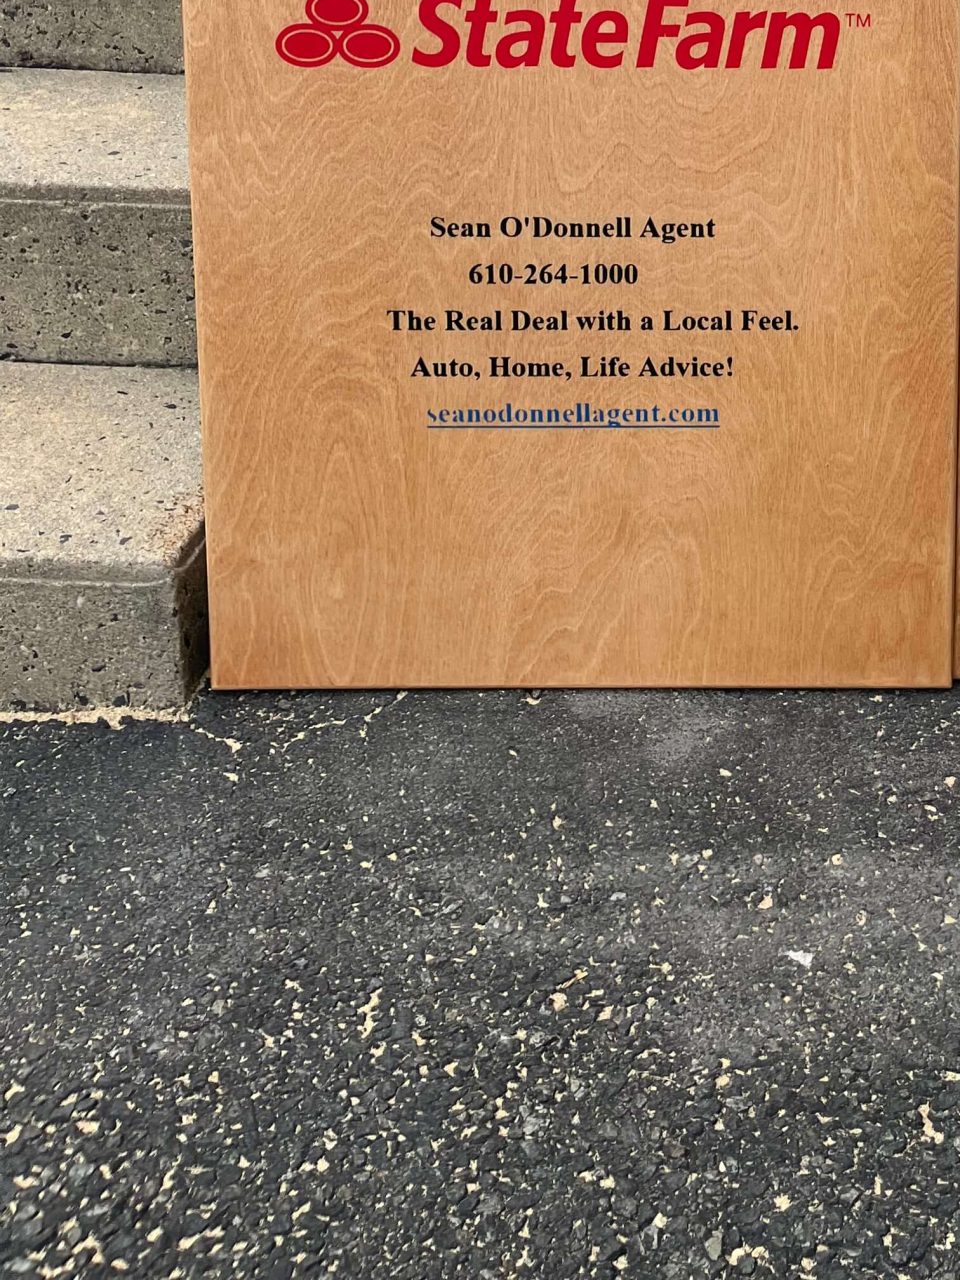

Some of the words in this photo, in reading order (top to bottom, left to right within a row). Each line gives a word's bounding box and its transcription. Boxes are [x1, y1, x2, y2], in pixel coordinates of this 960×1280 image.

[431, 217, 491, 237] Sean
[501, 217, 631, 237] O'Donnell
[640, 218, 715, 243] Agent
[469, 264, 637, 284] 610-264-1000
[387, 311, 435, 330] The
[445, 310, 502, 330] Real
[512, 311, 567, 330] Deal
[576, 311, 630, 330] with
[641, 317, 653, 330] a
[664, 311, 732, 330] Local
[742, 311, 798, 330] Feel.
[411, 357, 480, 380] Auto,
[490, 357, 571, 380] Home,
[581, 357, 630, 376] Life
[639, 357, 732, 376] Advice!
[428, 403, 720, 427] seanodonnellagent.com
